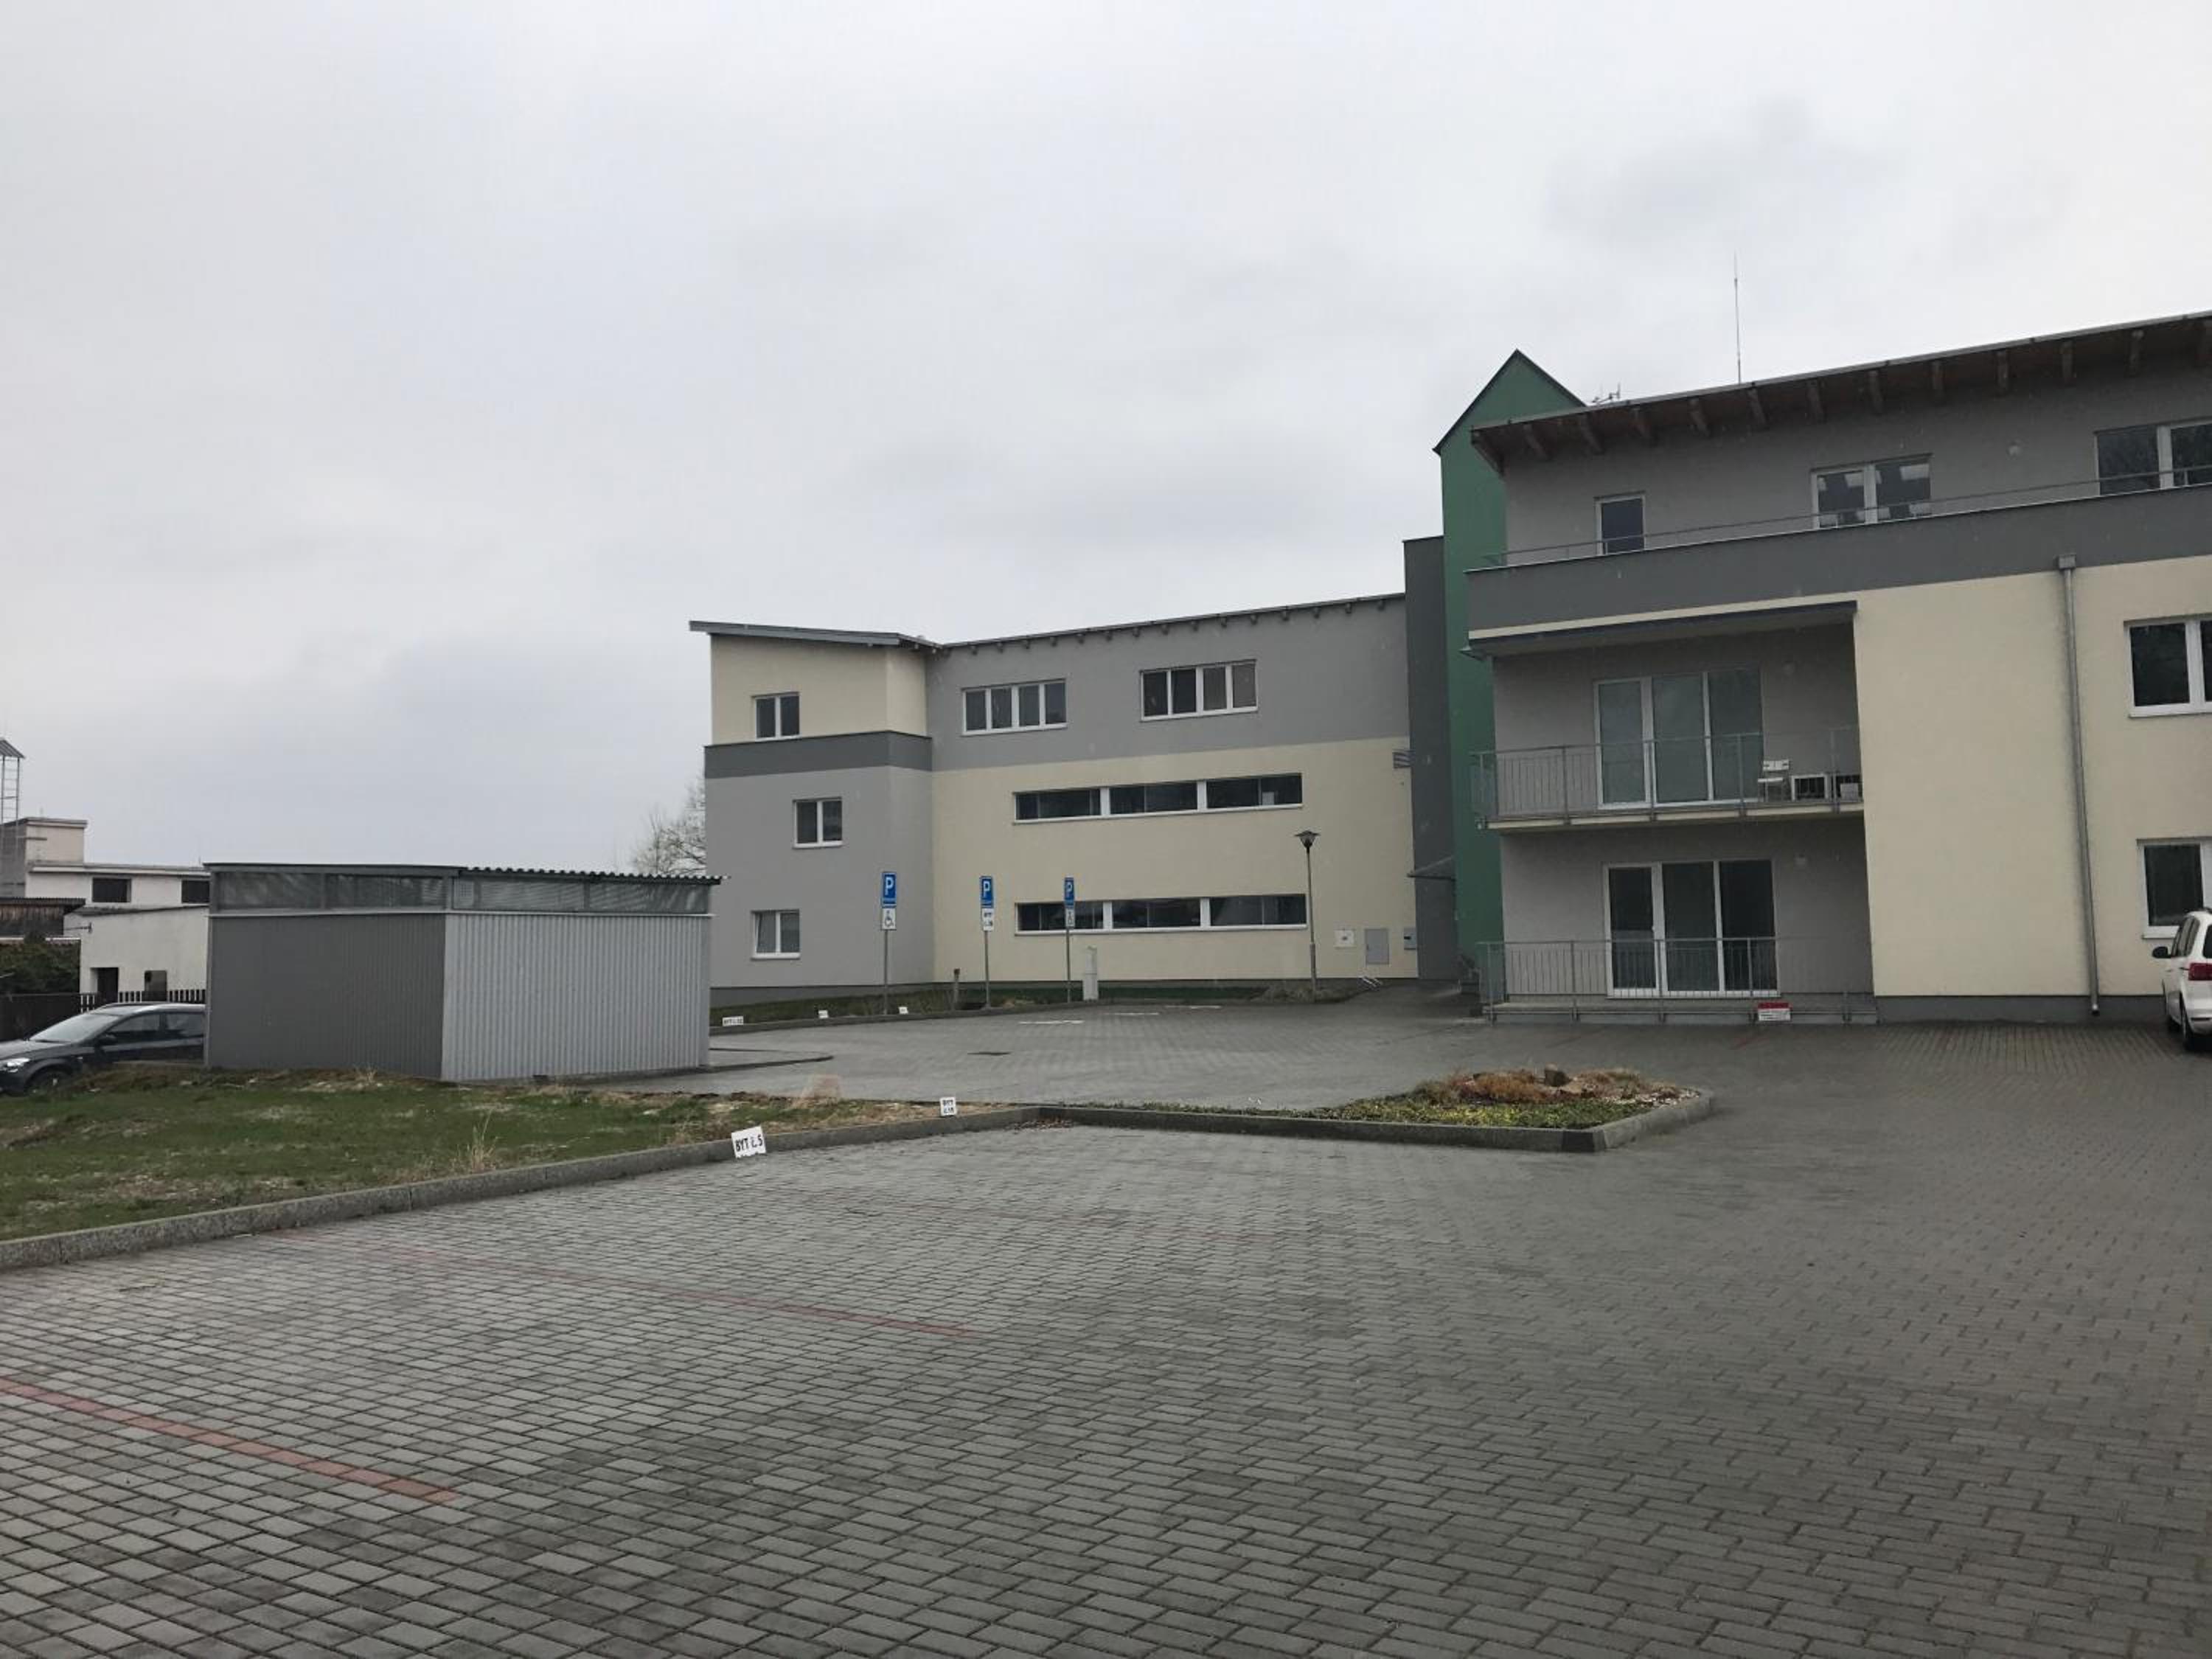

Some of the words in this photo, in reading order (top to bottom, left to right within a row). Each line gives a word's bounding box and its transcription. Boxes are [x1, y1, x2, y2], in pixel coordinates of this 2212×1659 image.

[885, 877, 894, 896] P
[983, 880, 991, 898] P
[1066, 881, 1073, 898] P
[736, 1138, 748, 1152] BYT
